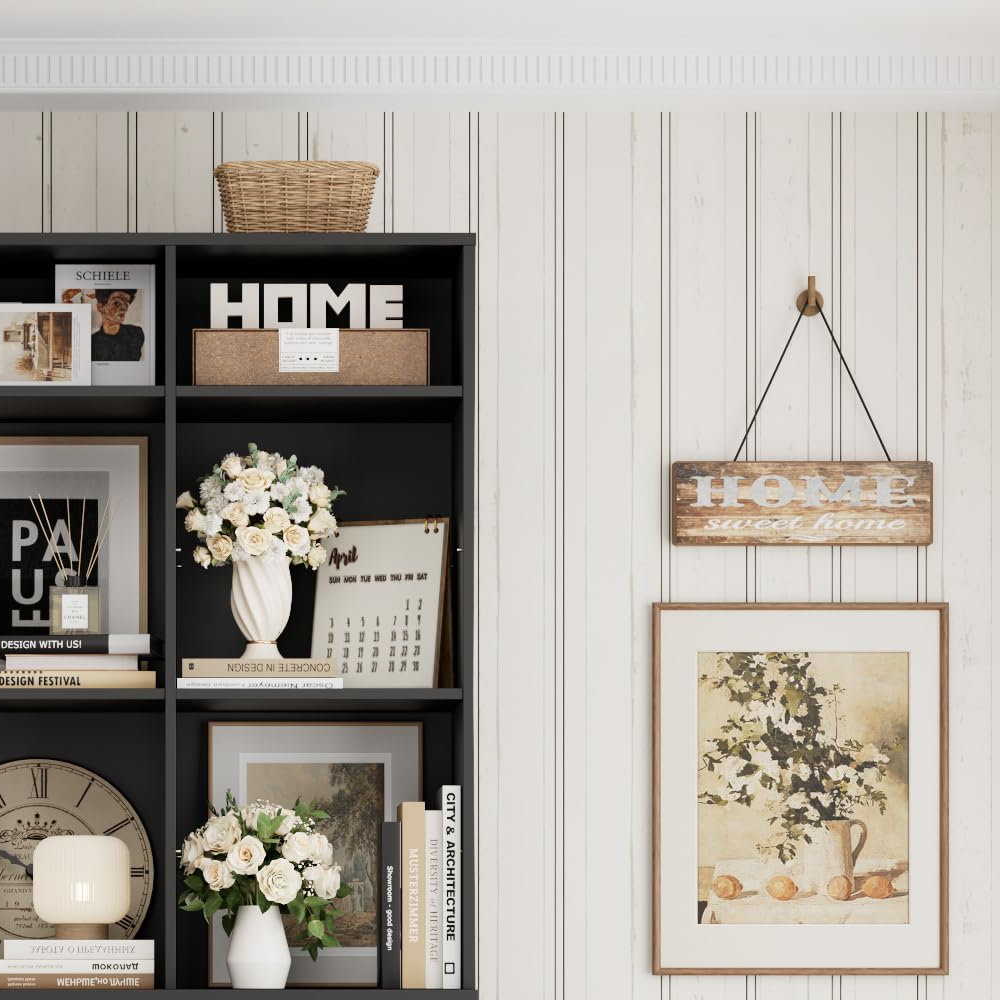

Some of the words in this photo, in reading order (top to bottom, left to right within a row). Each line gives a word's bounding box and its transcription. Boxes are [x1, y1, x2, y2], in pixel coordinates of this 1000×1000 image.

[75, 270, 131, 281] SCHIELE
[210, 282, 404, 329] HOME
[689, 474, 917, 508] HOME
[703, 514, 802, 531] sweet
[812, 512, 906, 531] home
[328, 545, 358, 570] April
[328, 576, 340, 584] SUN
[343, 576, 357, 584] MON
[360, 575, 372, 583] TUE
[374, 574, 387, 582] WED
[404, 573, 414, 581] FRI
[1, 640, 36, 650] DESIGN
[39, 640, 64, 649] WITH
[66, 640, 82, 648] US!
[227, 662, 263, 672] DESIGN
[266, 662, 275, 672] IN
[278, 662, 331, 672] CONCRETE
[38, 676, 81, 686] FESTIVAL
[446, 792, 456, 823] CITY
[446, 826, 456, 836] &
[429, 839, 438, 894] DIVERSITY
[386, 866, 394, 903] Showroom
[446, 840, 456, 942] ARCHITECTURE
[408, 848, 418, 943] MUSTERZIMMER
[385, 909, 394, 927] good
[385, 928, 394, 951] design
[429, 911, 438, 963] HERITAGE
